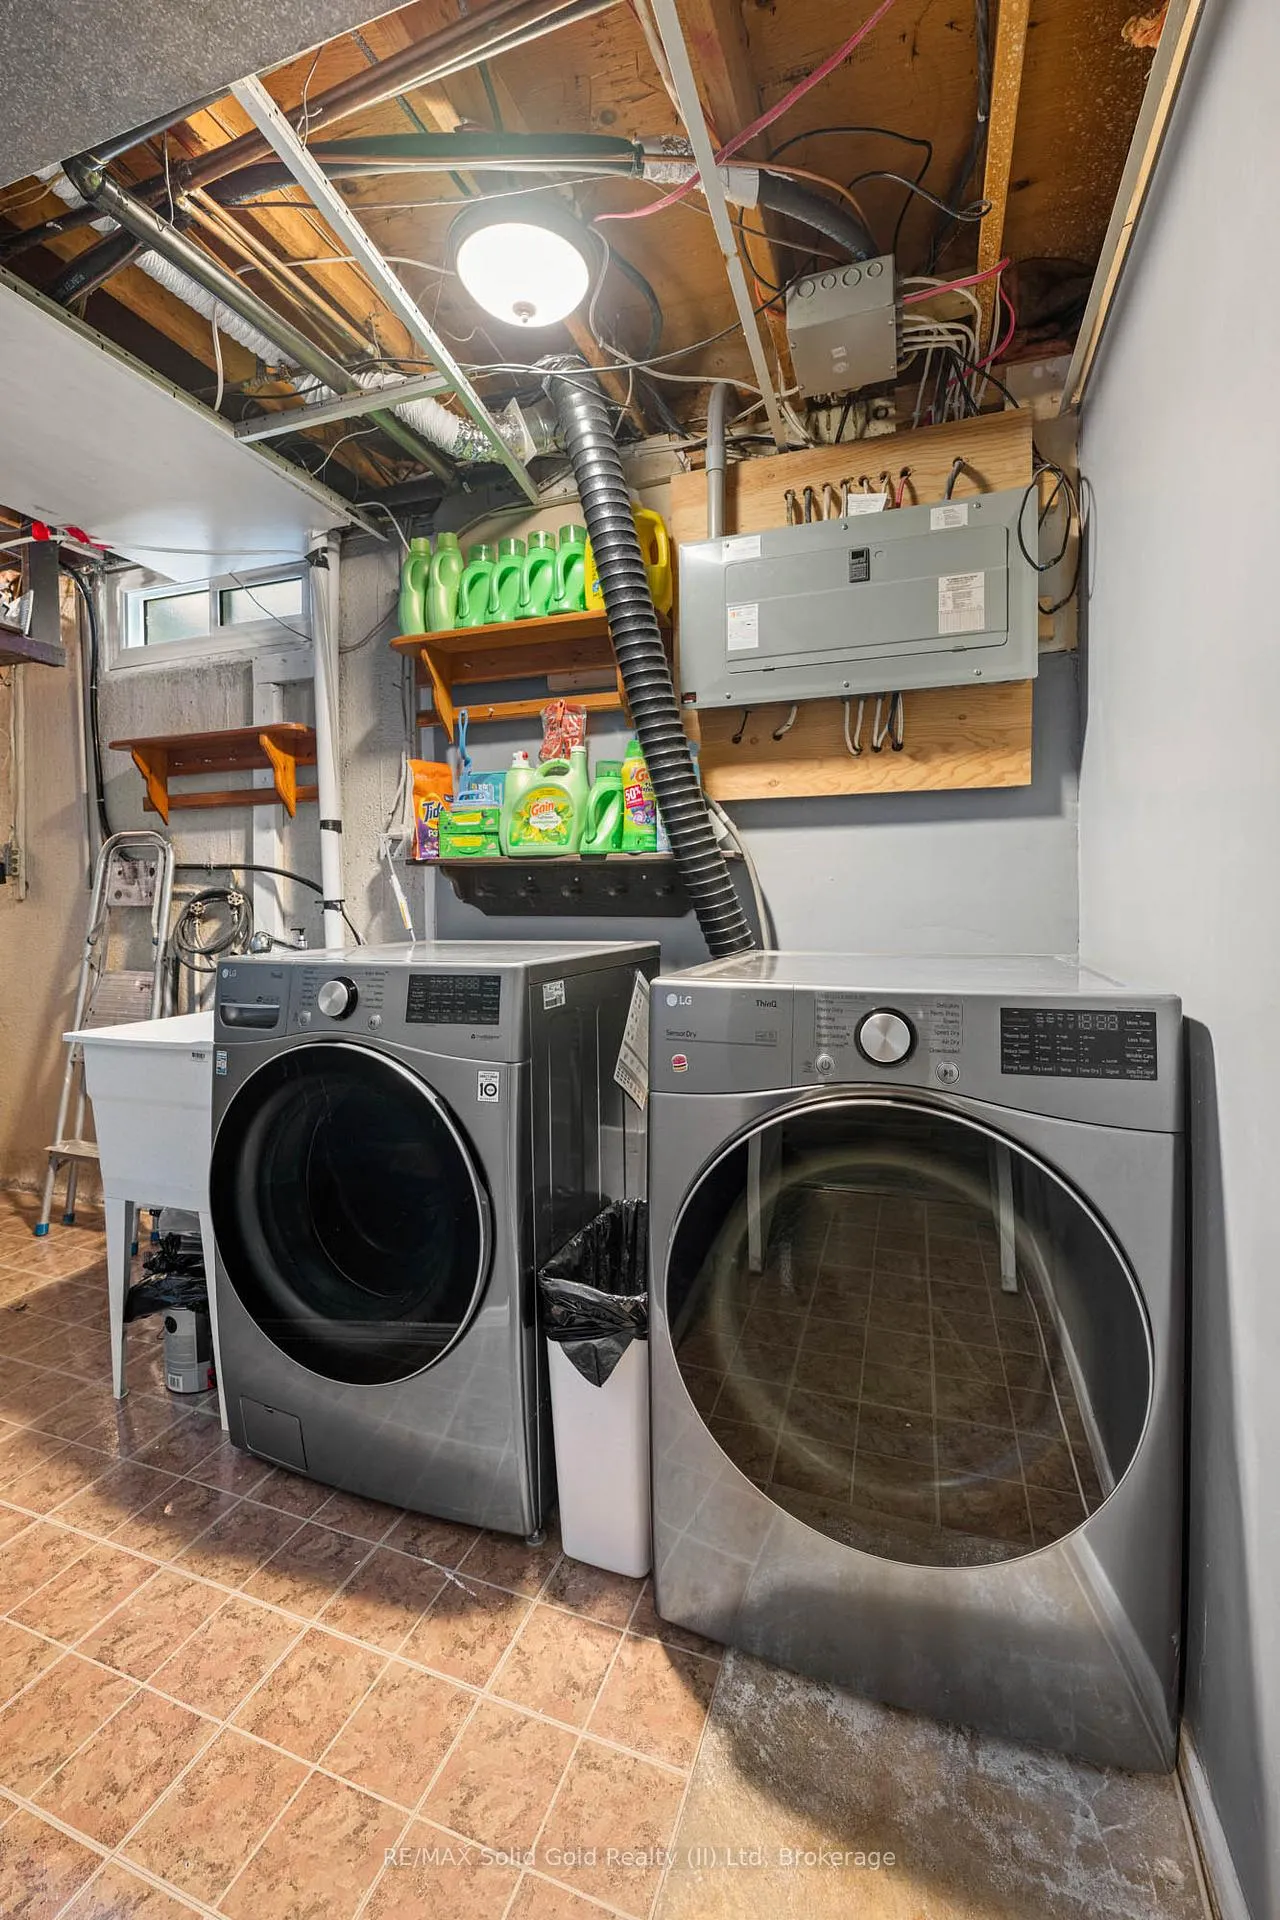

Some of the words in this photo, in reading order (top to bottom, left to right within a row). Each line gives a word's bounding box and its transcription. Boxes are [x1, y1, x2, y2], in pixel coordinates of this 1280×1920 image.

[625, 786, 642, 801] 50%
[422, 801, 444, 823] Tid
[530, 802, 555, 816] Gain
[679, 996, 693, 1005] LG
